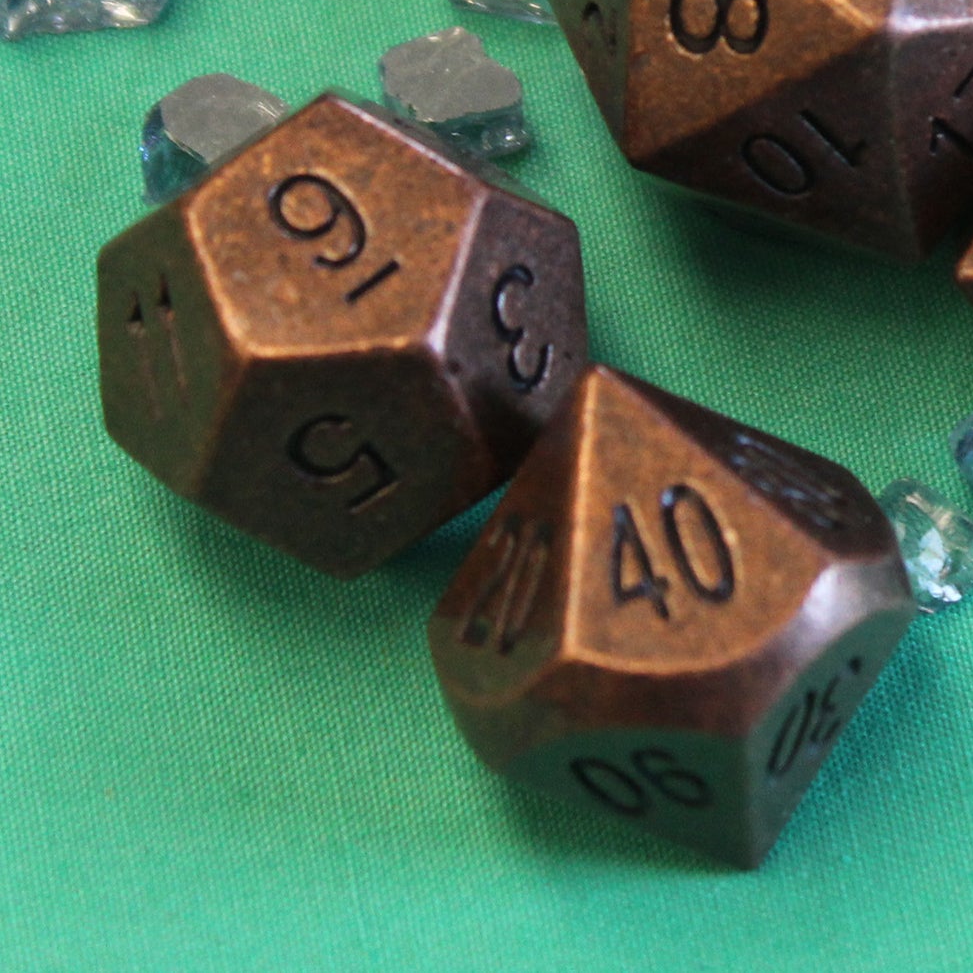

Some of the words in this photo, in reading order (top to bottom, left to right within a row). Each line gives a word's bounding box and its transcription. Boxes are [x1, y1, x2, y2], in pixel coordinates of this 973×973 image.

[741, 109, 876, 198] 10
[490, 262, 553, 395] 3
[287, 413, 400, 515] 5
[611, 483, 737, 623] 40
